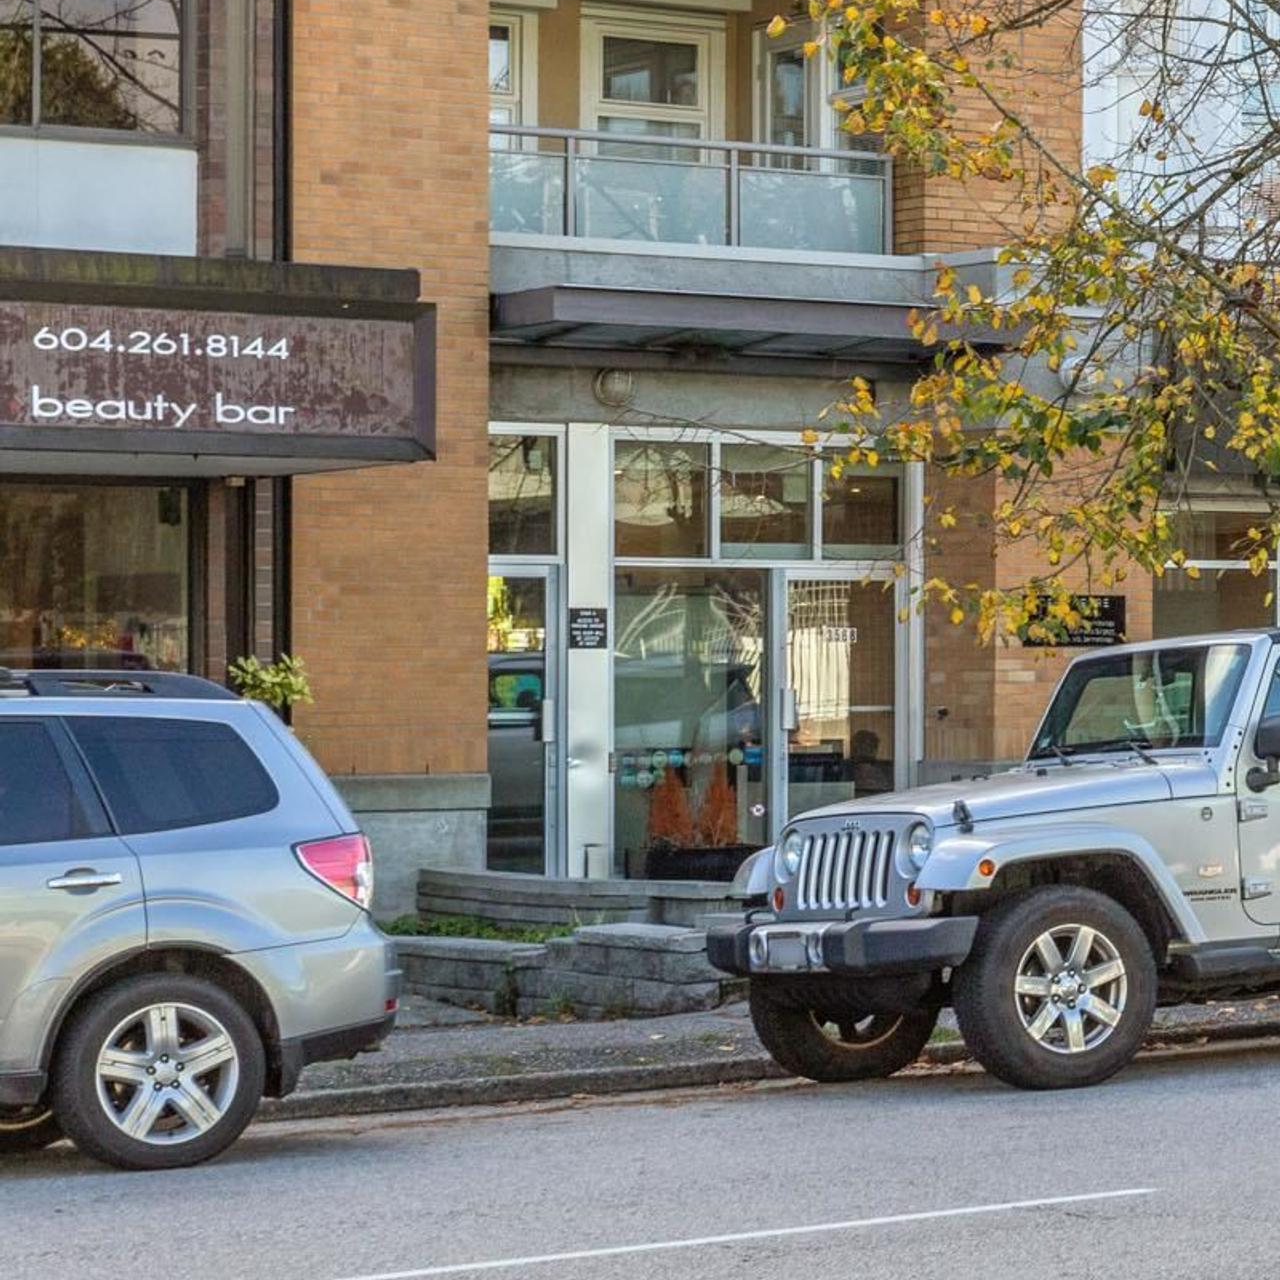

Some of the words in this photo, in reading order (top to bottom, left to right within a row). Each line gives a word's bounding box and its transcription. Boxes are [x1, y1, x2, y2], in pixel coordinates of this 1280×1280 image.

[33, 326, 289, 360] 604.261.8144
[31, 385, 197, 428] beauty
[215, 392, 295, 425] bar
